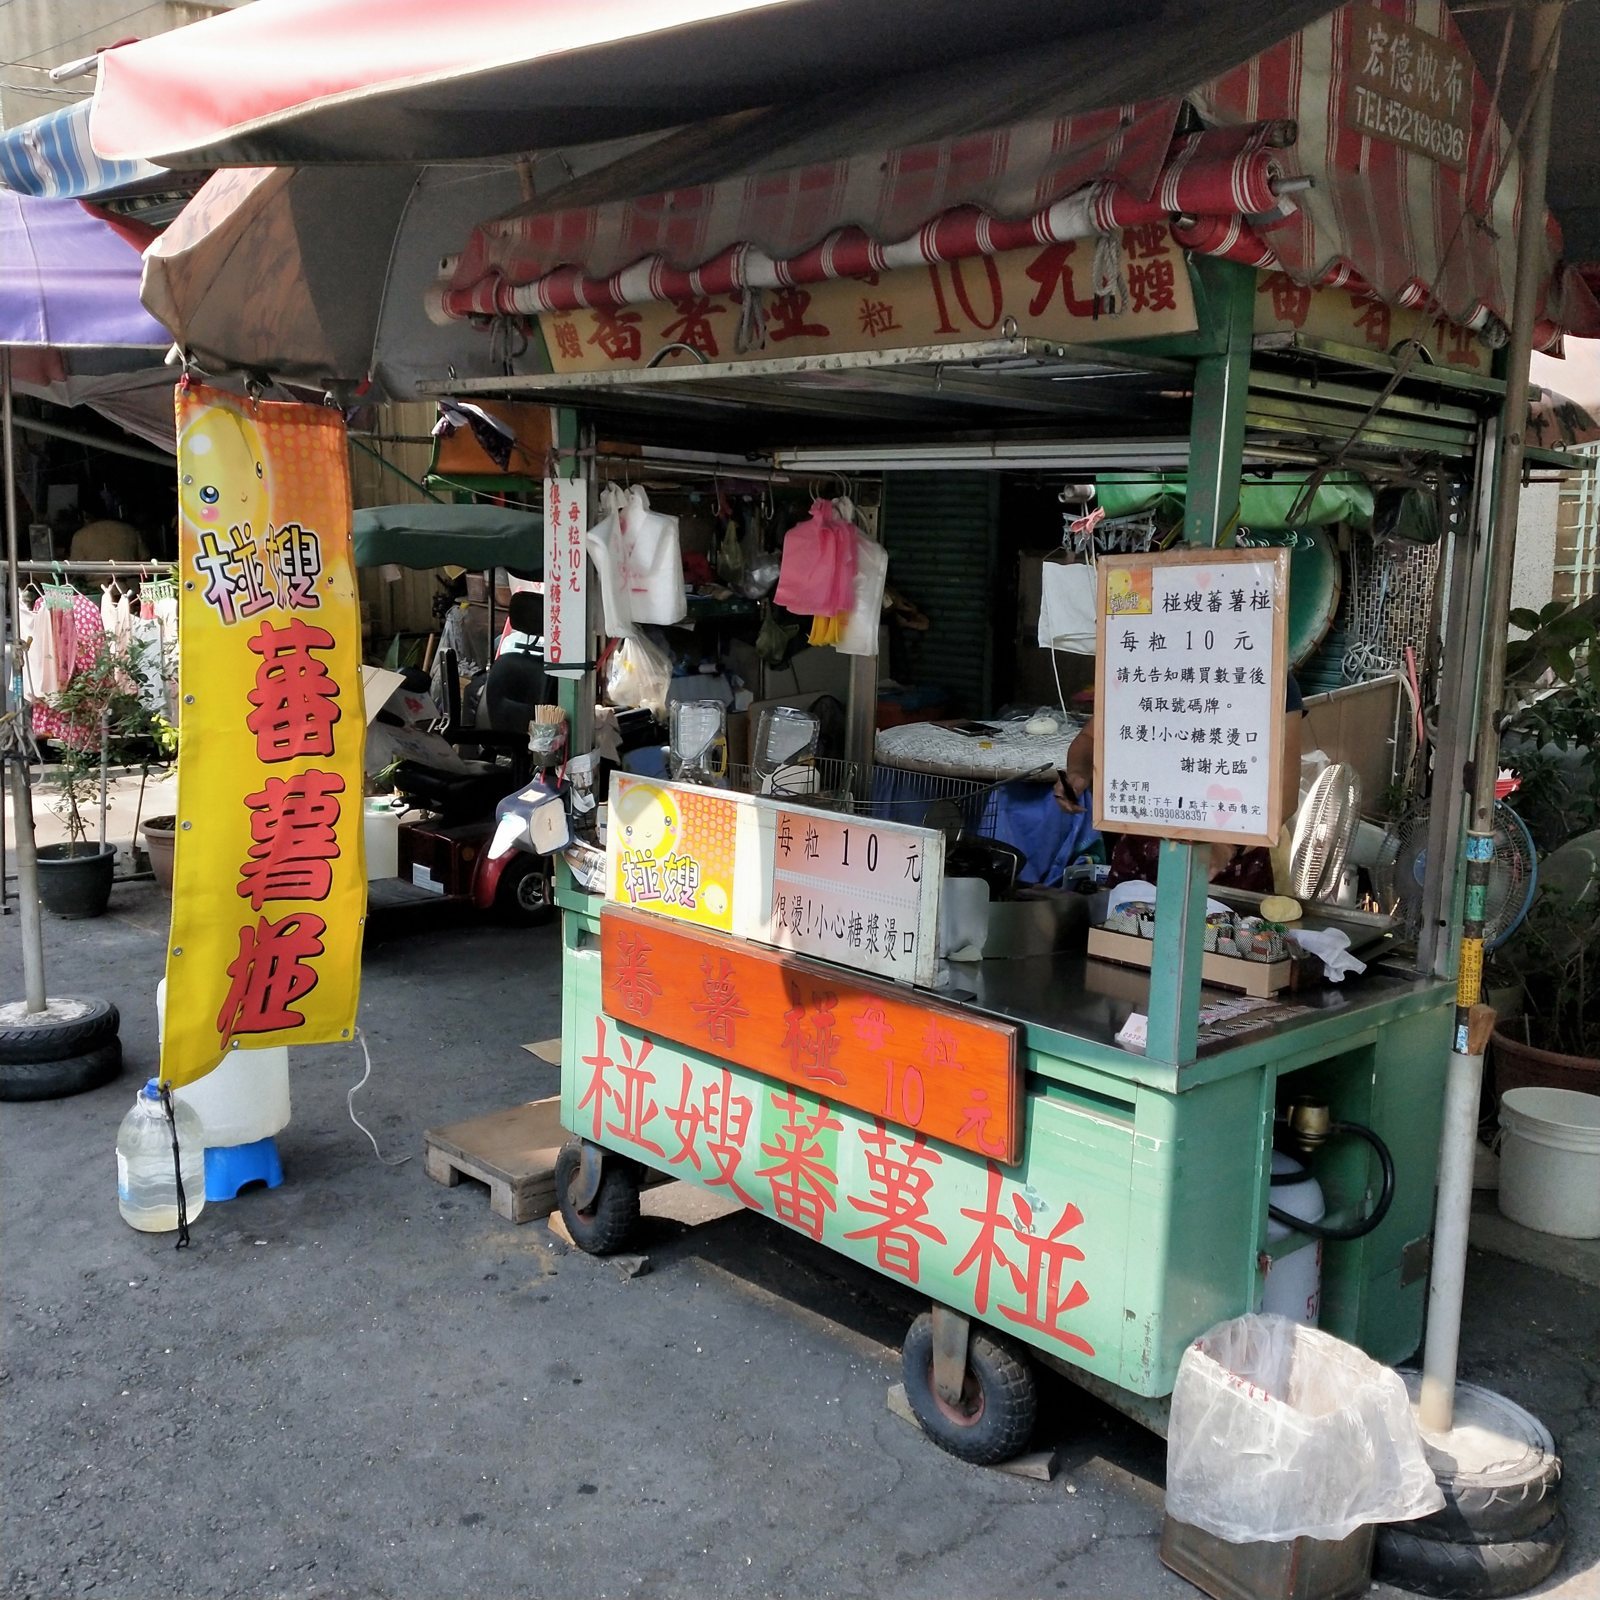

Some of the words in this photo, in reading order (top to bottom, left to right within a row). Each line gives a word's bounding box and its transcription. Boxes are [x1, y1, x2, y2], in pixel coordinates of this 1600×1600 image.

[568, 502, 581, 593] 每粒10元
[198, 523, 322, 626] 椪嫂
[1162, 588, 1272, 614] 椪嫂蕃薯椪
[1116, 665, 1267, 685] 請先告知購買數量後
[1138, 697, 1233, 715] 領取號碼牌。
[1110, 779, 1150, 792] 素食可用
[1180, 757, 1248, 775] 謝謝光臨
[218, 618, 344, 1050] 蕃薯椪
[622, 849, 700, 909] 椪嫂
[577, 1016, 1096, 1357] 椪嫂蕃薯椪
